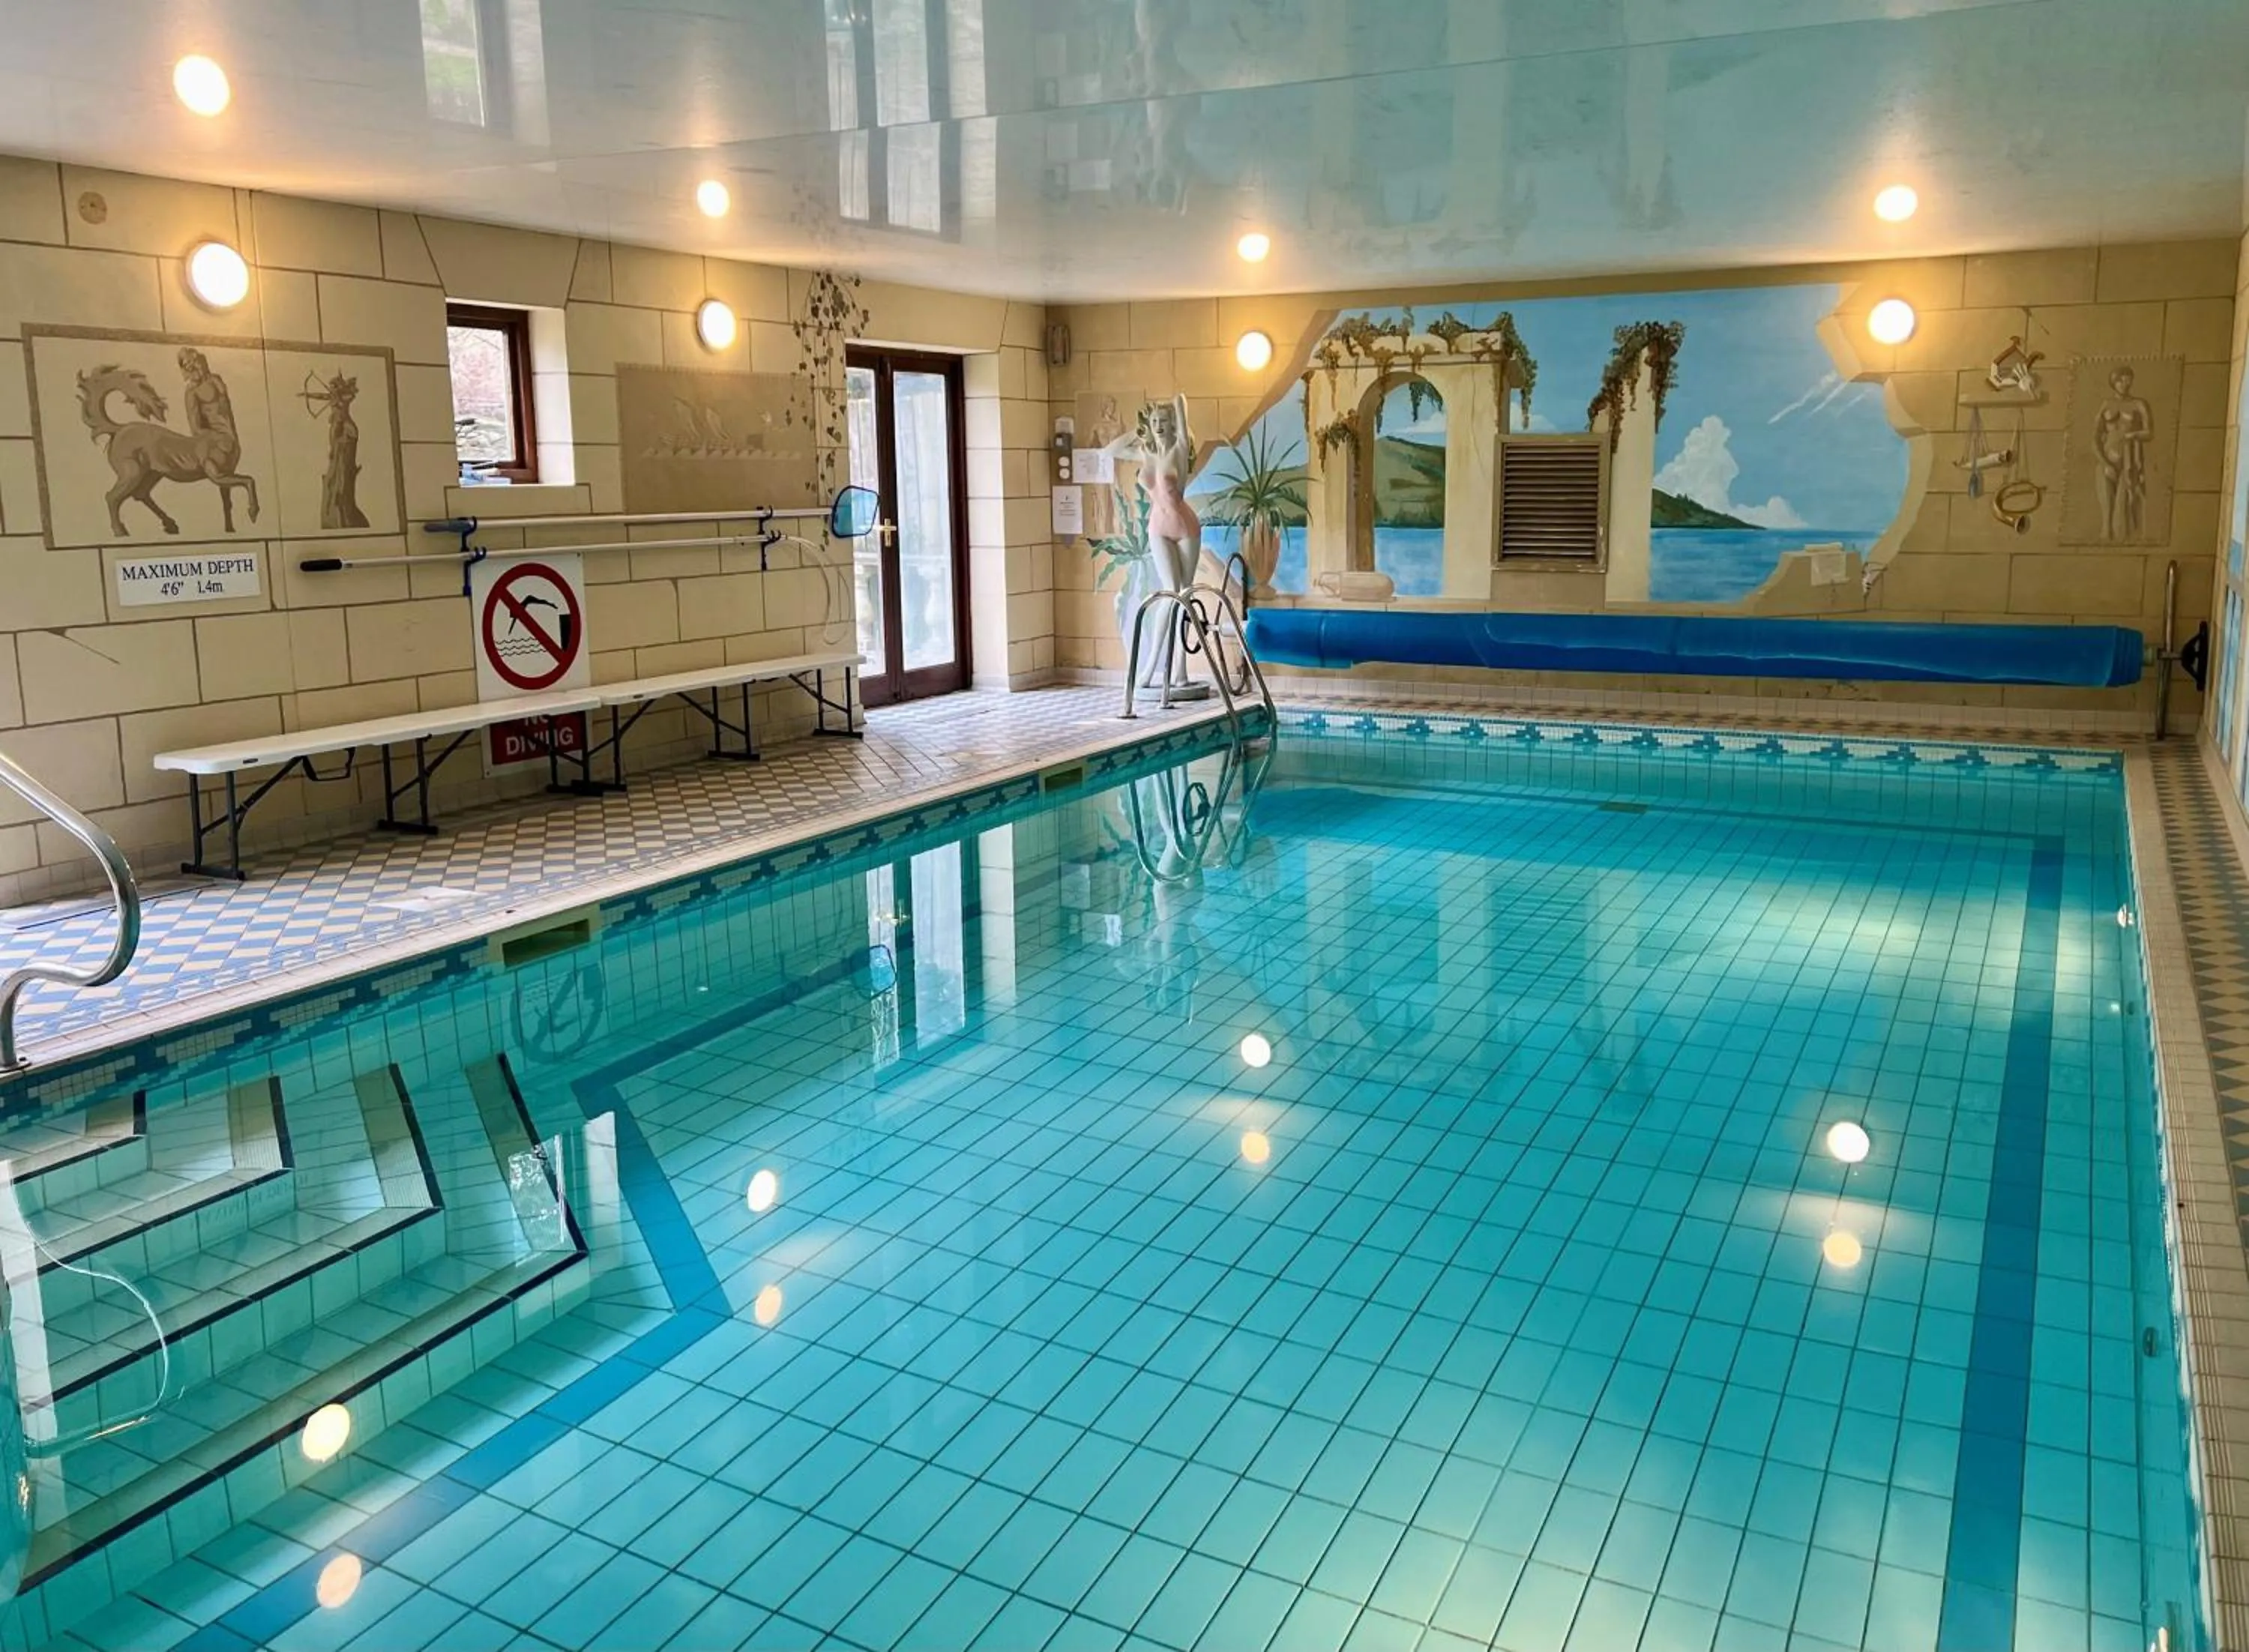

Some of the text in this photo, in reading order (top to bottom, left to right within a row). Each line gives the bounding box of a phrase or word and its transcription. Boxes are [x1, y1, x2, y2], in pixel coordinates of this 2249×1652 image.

[122, 558, 253, 580] MAXIMUM DEPTH
[160, 579, 223, 596] 4'6" 1.4m
